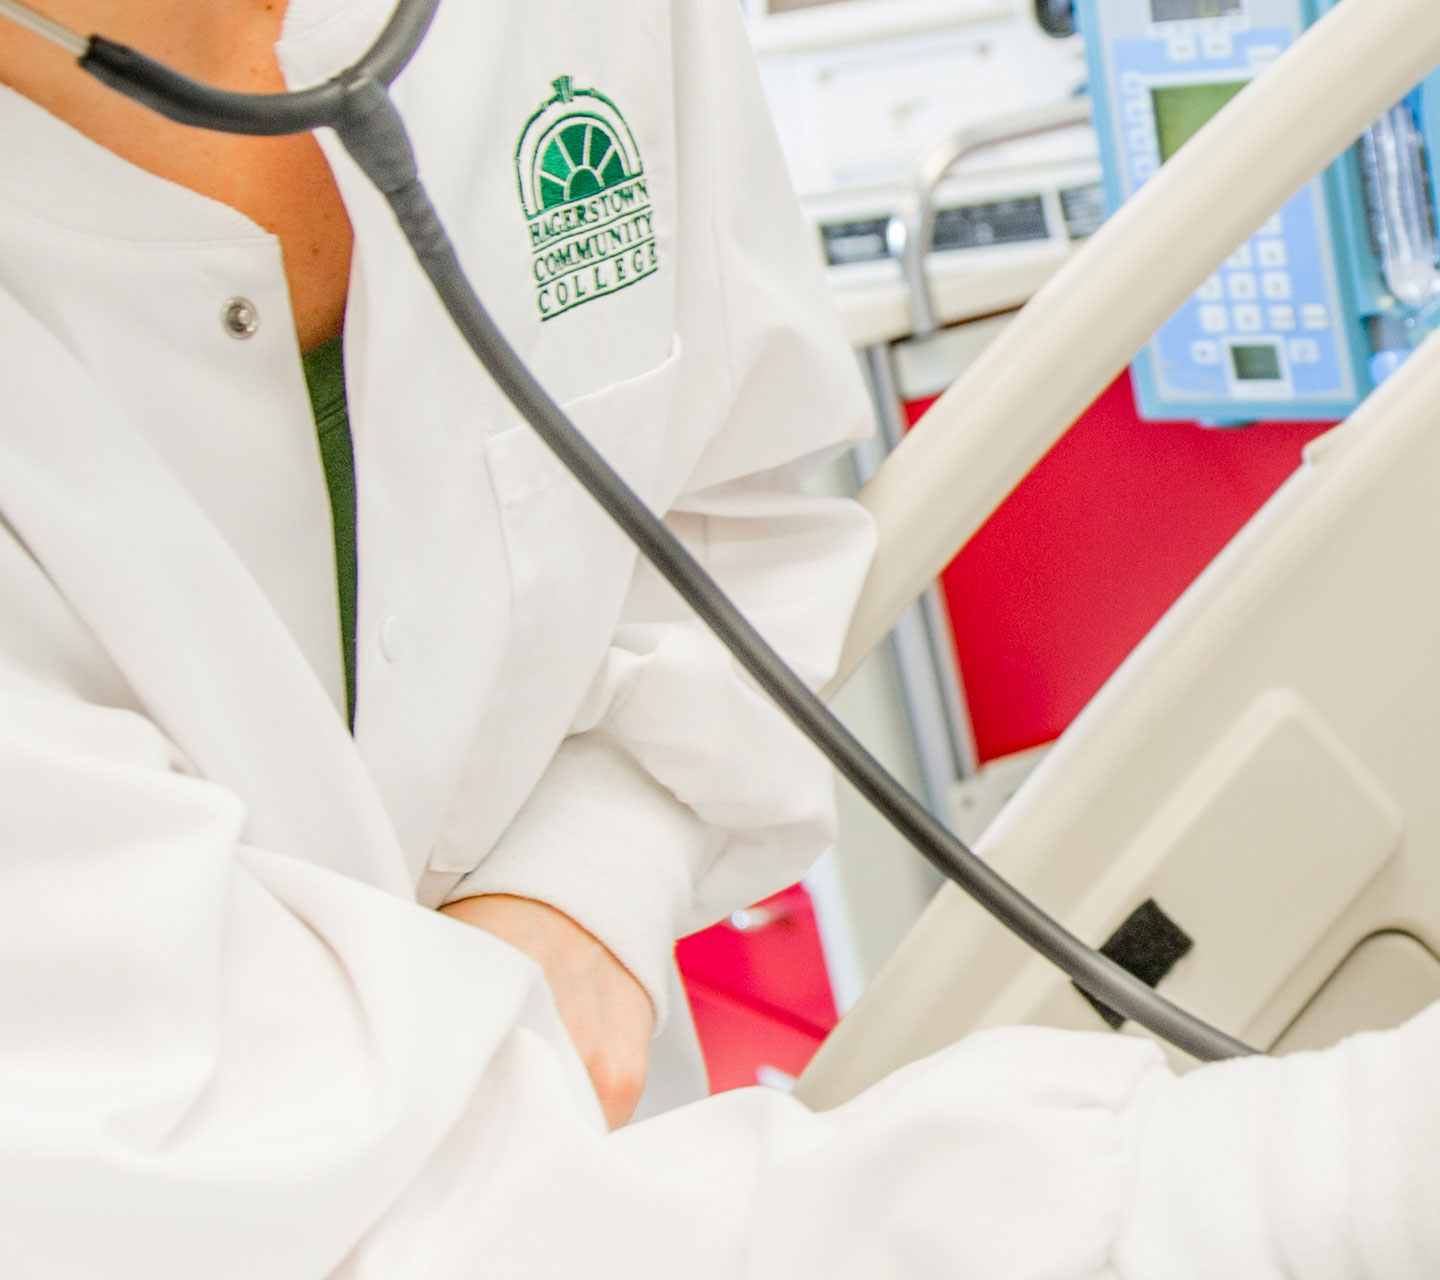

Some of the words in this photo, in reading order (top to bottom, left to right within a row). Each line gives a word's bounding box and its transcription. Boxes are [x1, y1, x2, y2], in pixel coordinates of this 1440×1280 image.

[529, 179, 649, 247] HAGERSTOWN
[533, 210, 654, 282] COMMUNITY
[537, 242, 658, 314] COLLEGE
